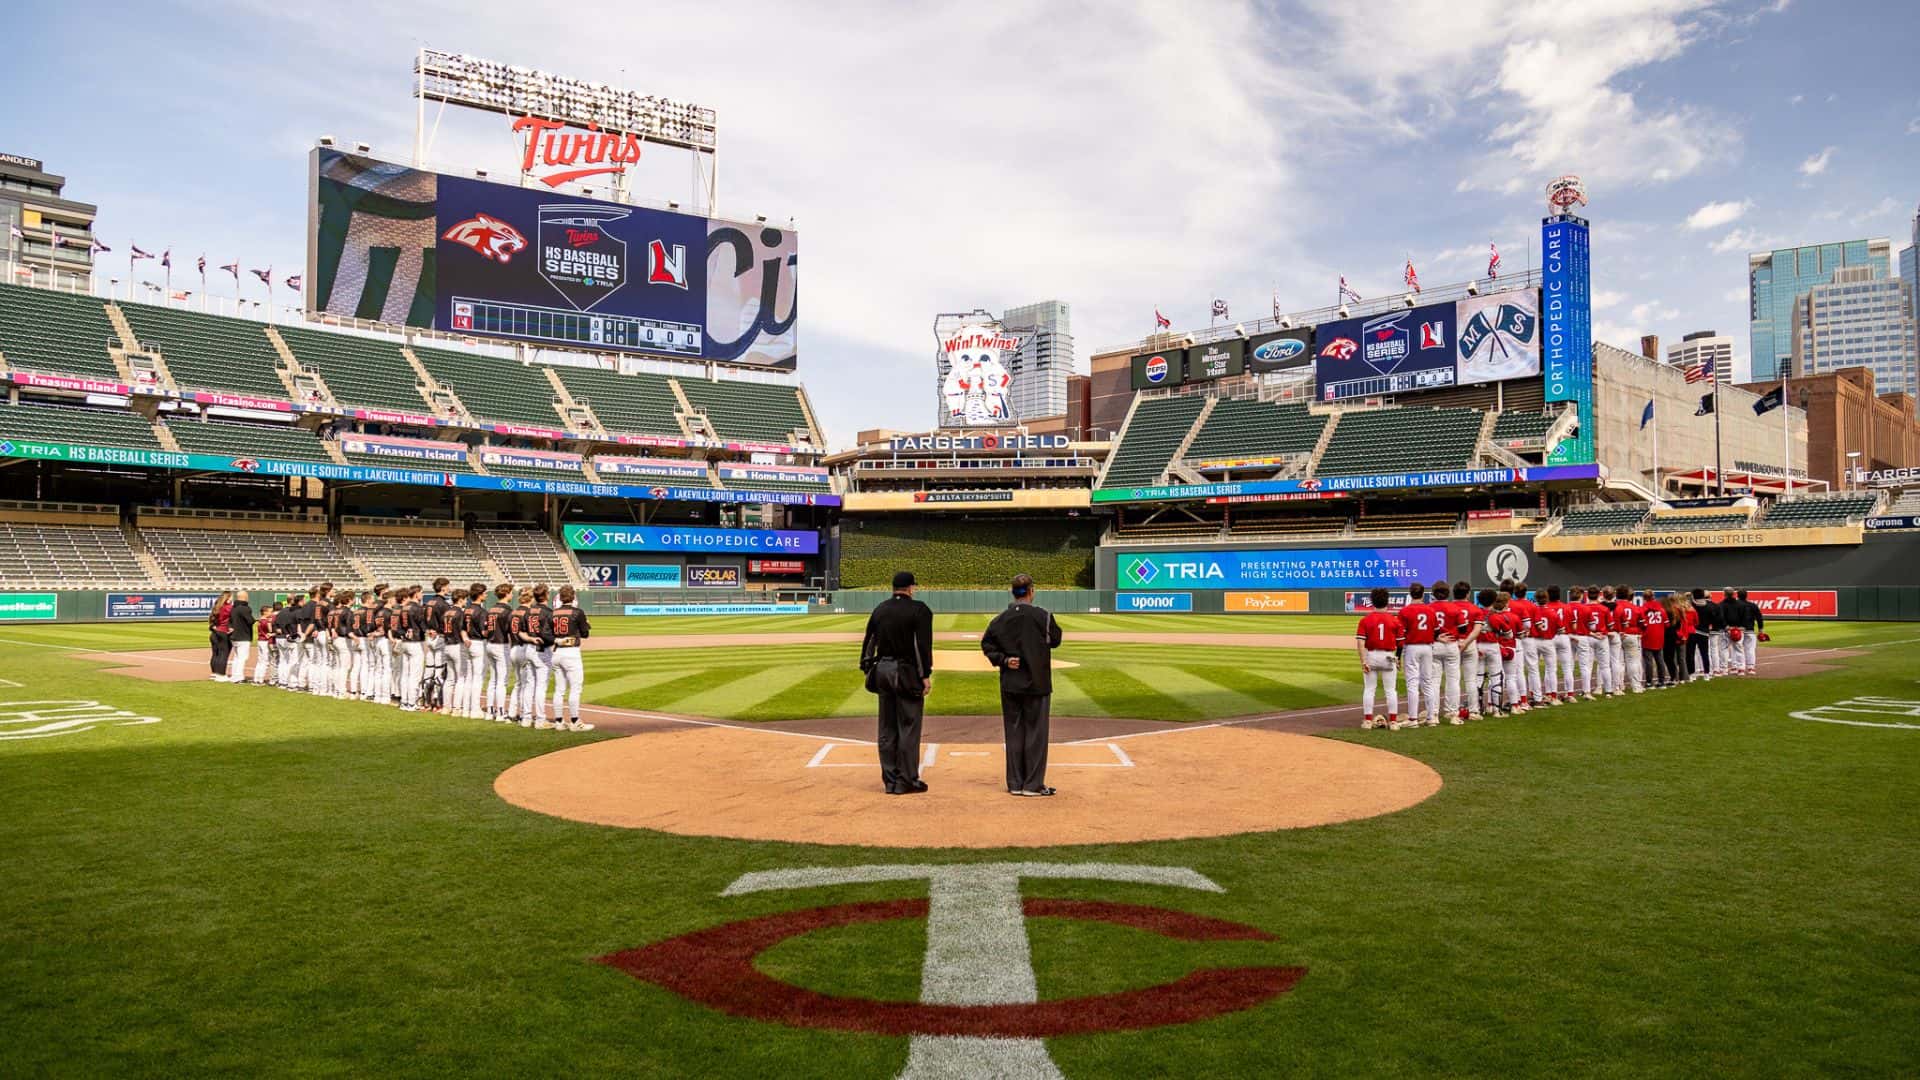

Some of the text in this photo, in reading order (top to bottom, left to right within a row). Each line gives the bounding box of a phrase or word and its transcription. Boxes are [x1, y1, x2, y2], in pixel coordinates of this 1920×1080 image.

[512, 116, 641, 184] Twins
[566, 228, 599, 247] Twins
[545, 246, 620, 268] HS BASEBALL
[546, 260, 618, 280] SERIES
[1549, 228, 1564, 394] ORTHOPEDIC CARE
[1508, 312, 1526, 335] S
[647, 329, 693, 344] 0 0 0
[945, 332, 1018, 352] Win! Twins!
[1264, 343, 1294, 358] Ford
[1367, 348, 1404, 358] SERIES
[1147, 365, 1167, 373] PEPSI
[28, 374, 118, 393] Treasure Island
[364, 411, 428, 425] Treasure Island
[891, 435, 1069, 449] TARGET FIELD
[19, 445, 189, 466] TRIA HS BASEBALL SERIES
[372, 445, 458, 462] Treasure Island
[504, 456, 579, 471] Home Run Deck
[624, 464, 698, 476] Treasure Island
[267, 461, 318, 476] LAKEVILLE
[319, 463, 350, 479] SOUTH
[352, 470, 362, 479] vs
[365, 468, 410, 482] LAKEVILLE
[411, 471, 439, 484] NORTH
[751, 472, 819, 482] Home Run Deck
[1329, 475, 1374, 490] LAKEVILLE
[1376, 474, 1406, 487] SOUTH
[1410, 477, 1419, 485] vs
[1422, 472, 1472, 485] LAKEVILLE
[1474, 470, 1506, 483] NORTH
[517, 481, 618, 496] TRIA HS BASEBALL SERIES
[1170, 488, 1179, 497] HS
[1181, 486, 1215, 496] BASEBALL
[1217, 484, 1242, 494] SERIES
[673, 489, 711, 500] LAKEVILLE
[712, 490, 734, 501] SOUTH
[745, 492, 780, 502] LAKEVILLE
[781, 493, 802, 504] NORTH
[1866, 518, 1903, 528] Corona
[602, 532, 801, 548] TRIA ORTHOPEDIC CARE
[1164, 562, 1224, 578] TRIA
[1240, 559, 1407, 569] PRESENTING PARTNER OF THE
[601, 567, 612, 580] 9
[1241, 568, 1418, 578] HIGH SCHOOL BASEBALL SERIES
[160, 598, 200, 608] POWERED
[201, 598, 210, 608] BY
[1132, 596, 1174, 609] uponor
[1245, 596, 1286, 608] Paycor
[1775, 596, 1811, 610] TRIP
[553, 616, 569, 634] 16
[1417, 614, 1427, 630] 2
[1648, 611, 1662, 624] 23
[1378, 624, 1384, 640] 1
